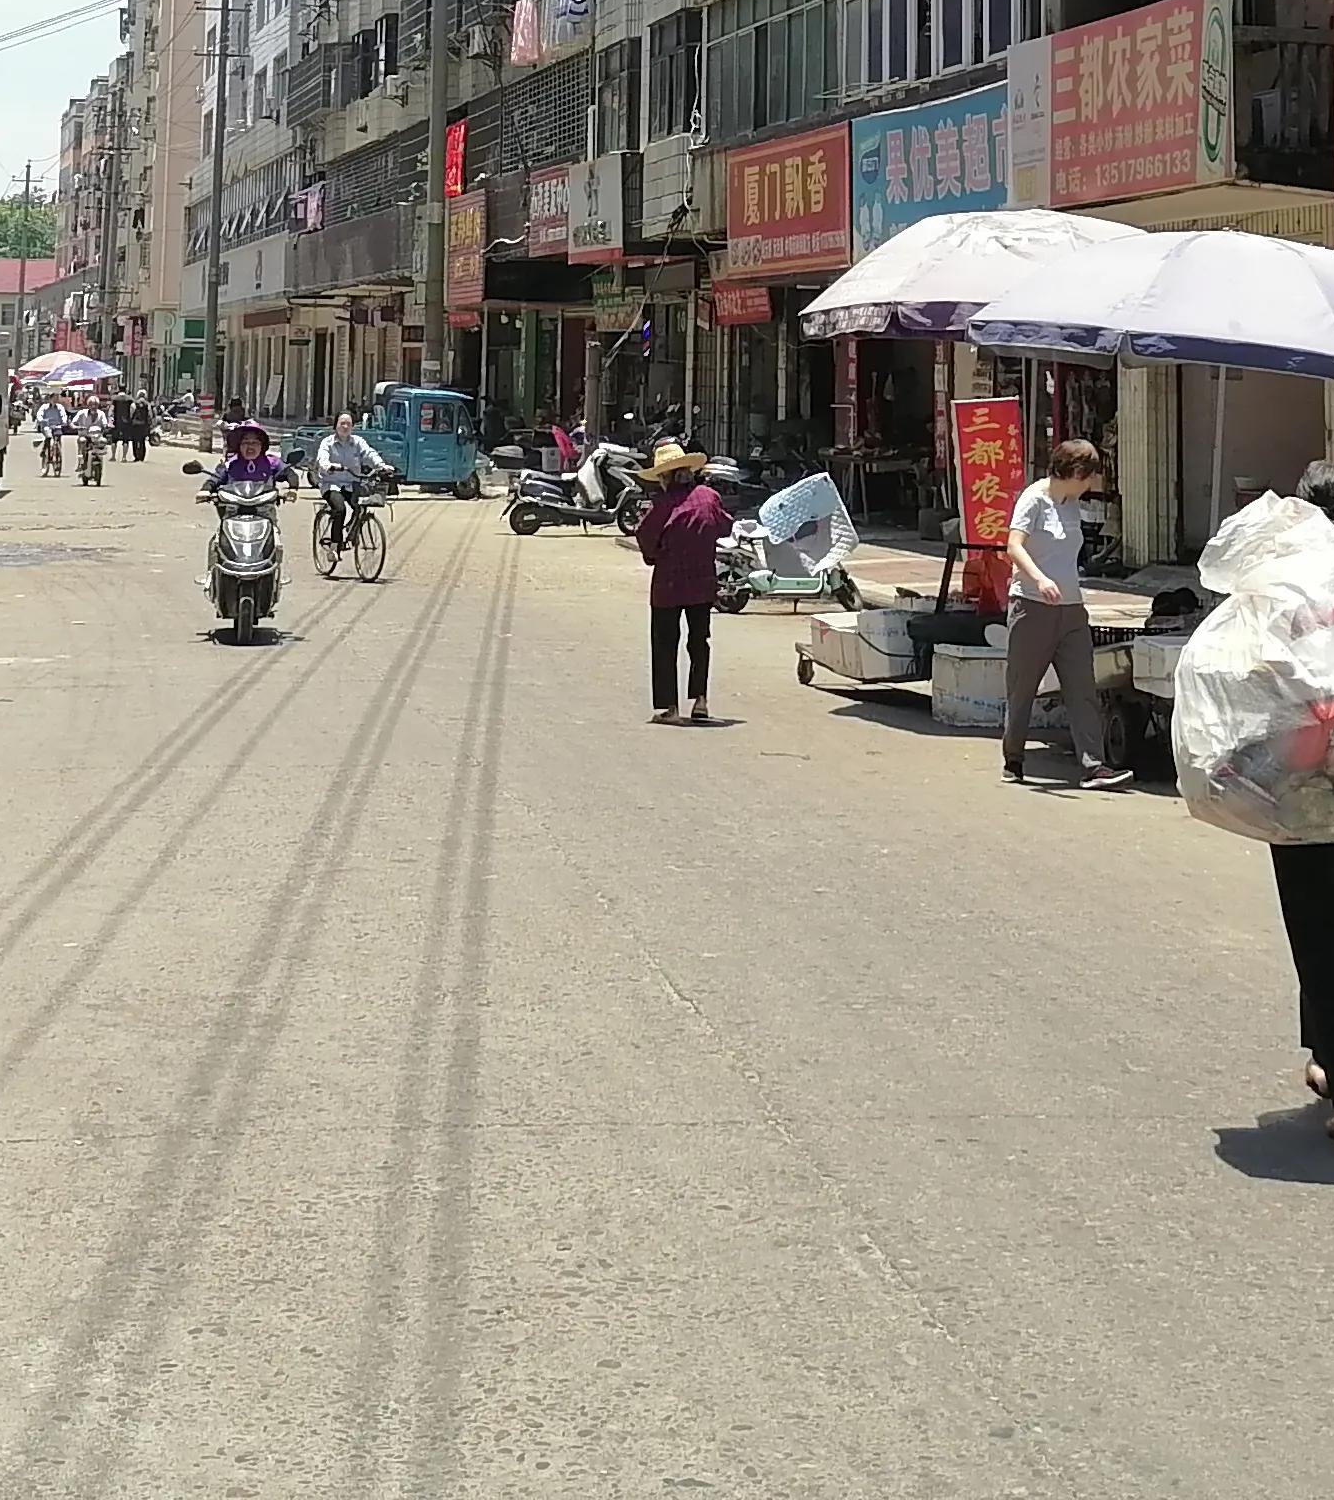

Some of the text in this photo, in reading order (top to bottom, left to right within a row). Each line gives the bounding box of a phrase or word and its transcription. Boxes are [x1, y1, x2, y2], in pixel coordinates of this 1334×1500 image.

[1053, 6, 1195, 125] 三都农家菜
[743, 149, 827, 227] 厦门飘香
[962, 407, 1010, 541] 三都农家
